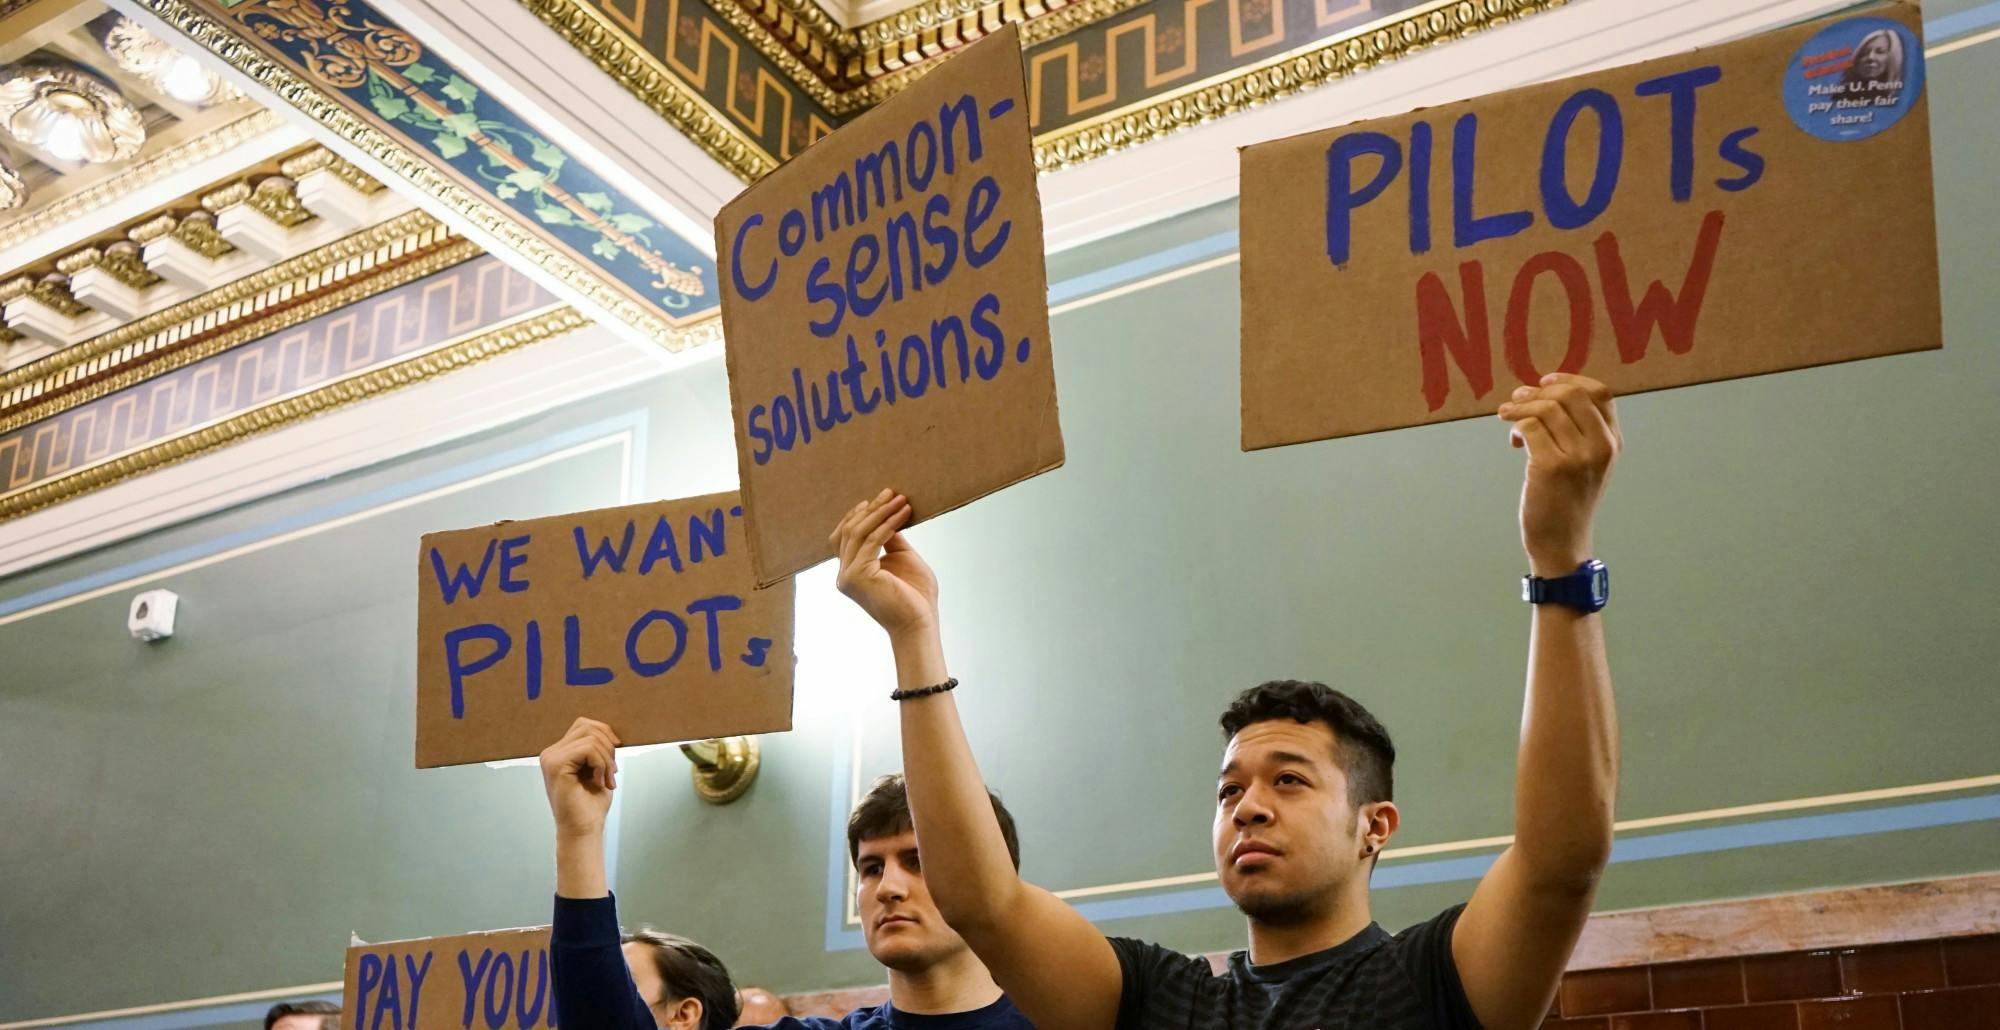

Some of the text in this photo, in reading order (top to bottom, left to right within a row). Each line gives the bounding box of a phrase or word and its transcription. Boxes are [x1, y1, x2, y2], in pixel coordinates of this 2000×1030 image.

[1808, 79, 1903, 96] Make U. Penn
[1808, 95, 1899, 114] pay their fair
[1830, 112, 1873, 125] share!
[731, 93, 1014, 302] Common-
[1326, 65, 1765, 269] PILOTs
[805, 175, 1013, 338] sense
[1415, 210, 1725, 413] NOW
[748, 292, 1031, 466] solutions.
[430, 505, 743, 605] WE WAN
[445, 594, 772, 719] PILOTs
[355, 948, 557, 1030] PAY YOU
